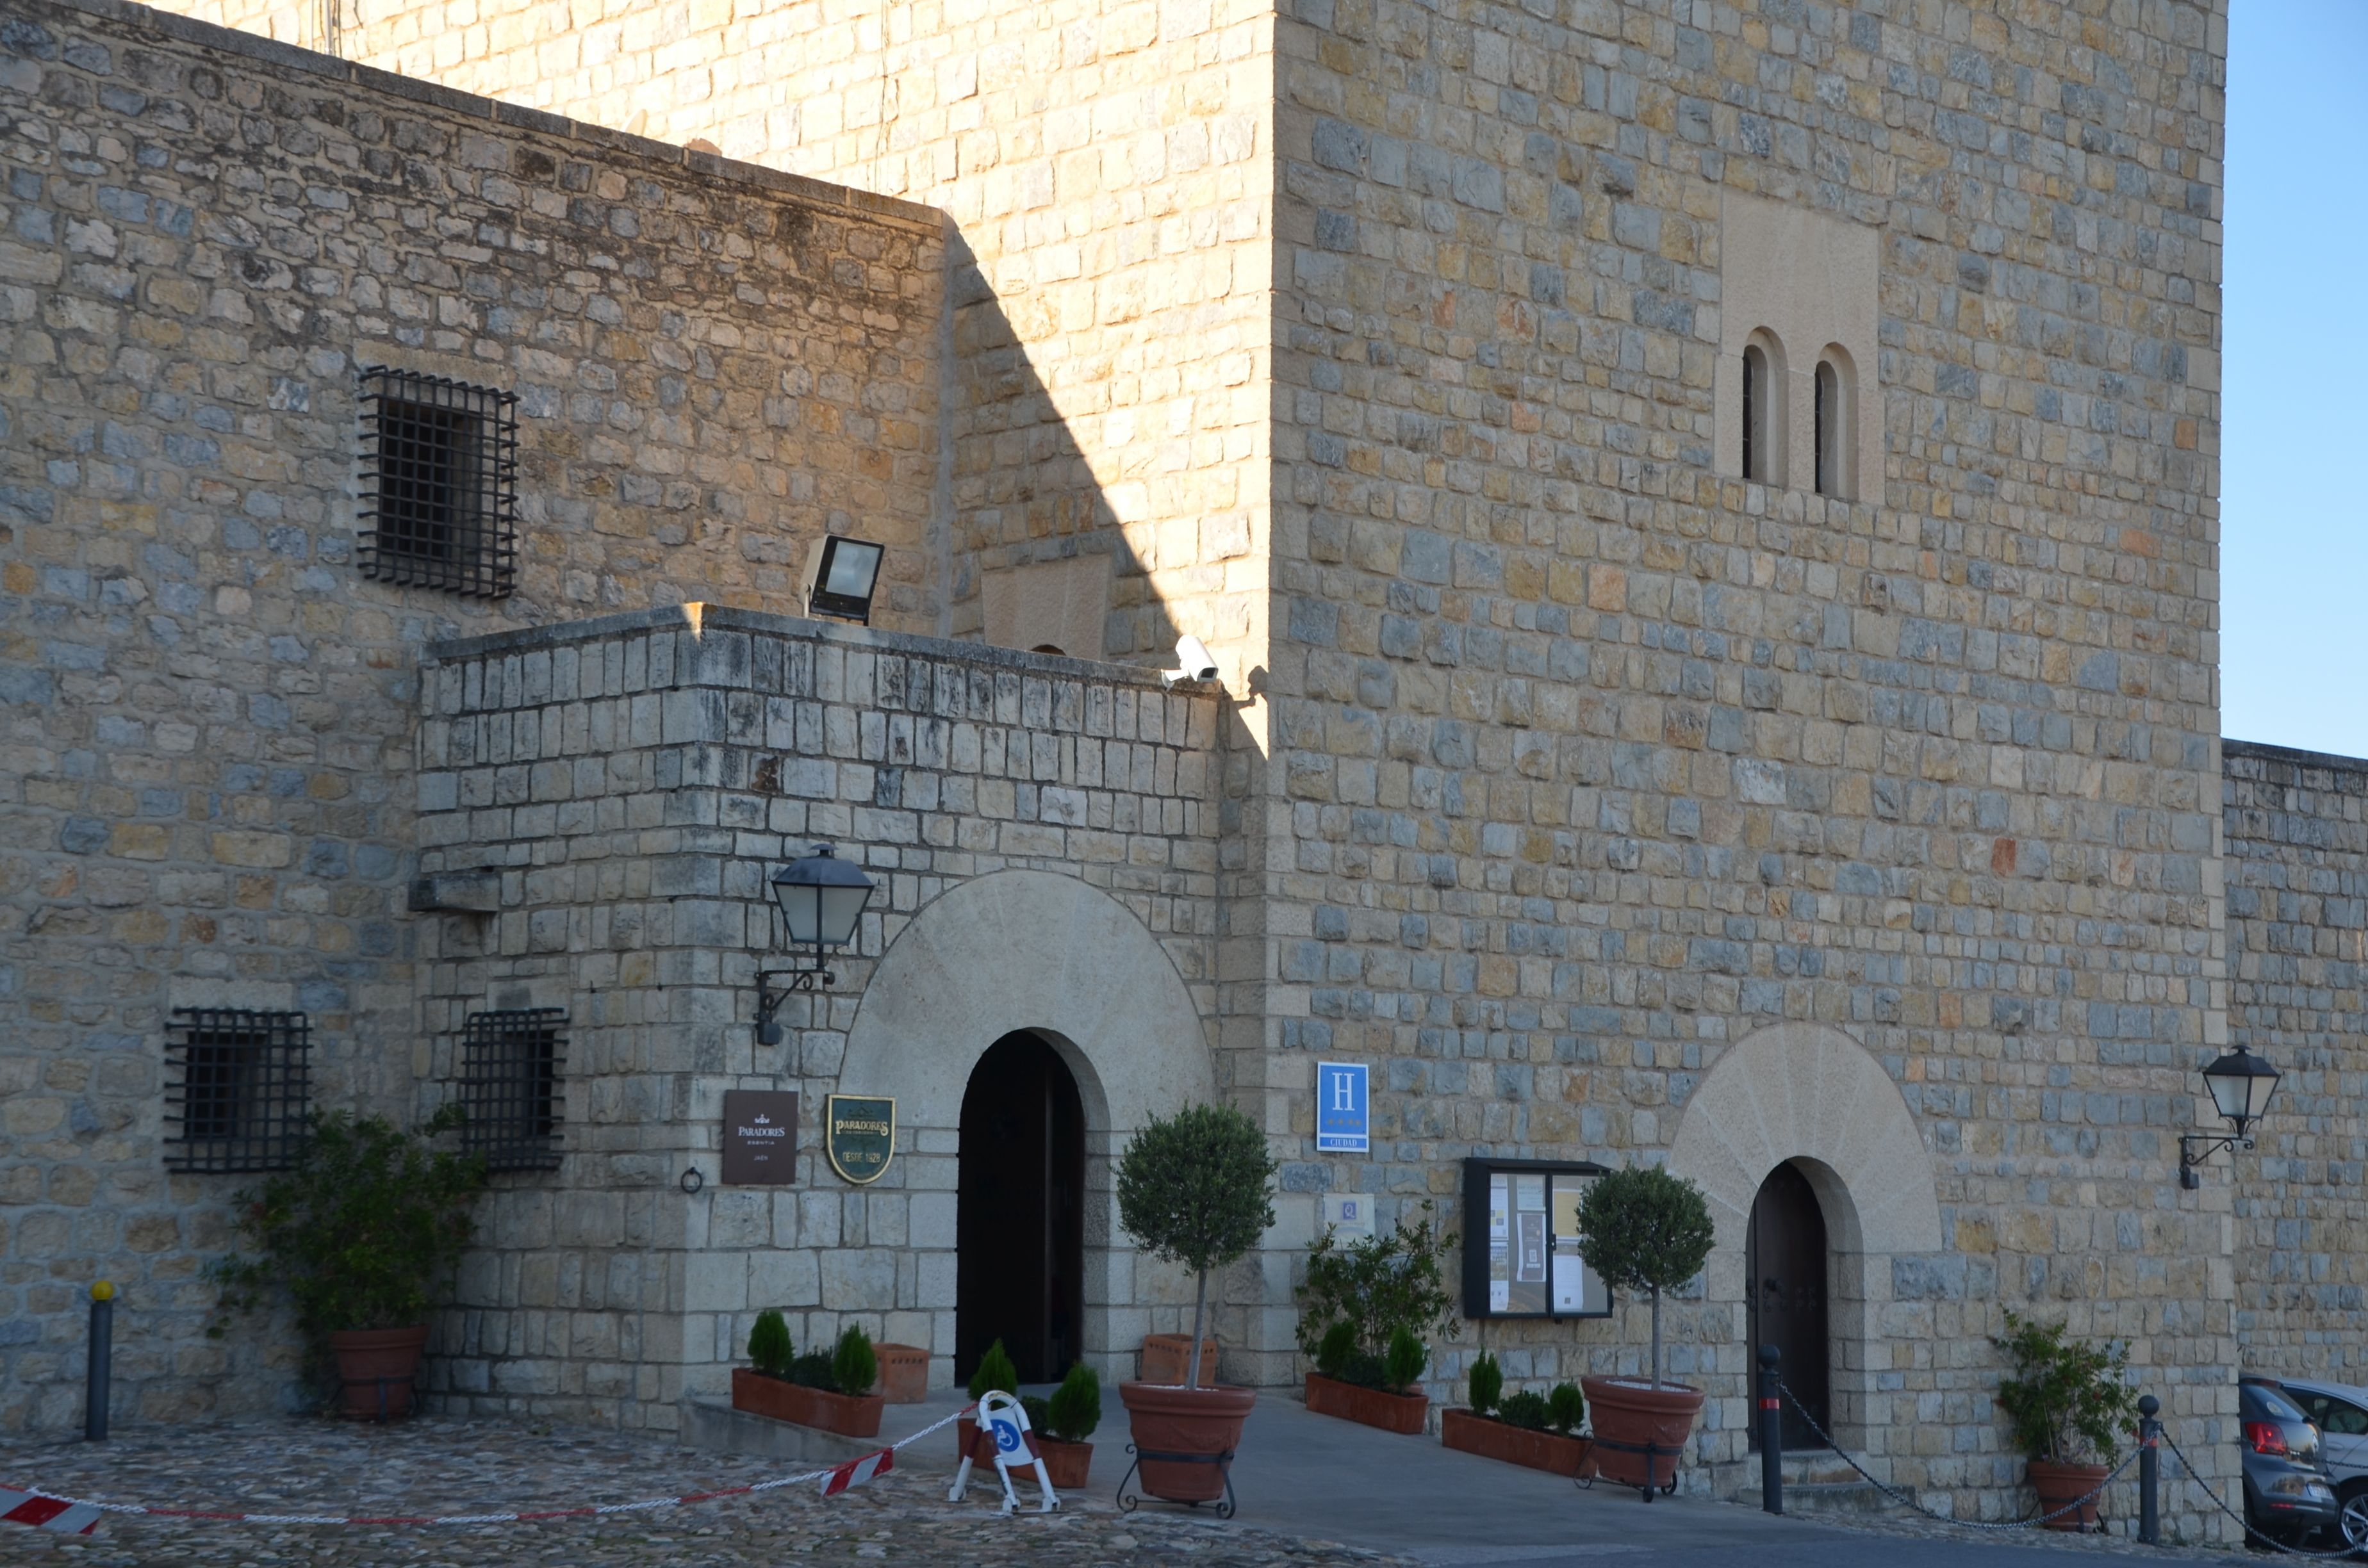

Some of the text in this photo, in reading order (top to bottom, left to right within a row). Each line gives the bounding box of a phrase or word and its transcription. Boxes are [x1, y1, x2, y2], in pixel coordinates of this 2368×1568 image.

[1332, 1072, 1355, 1111] H
[738, 1126, 785, 1137] PARADORES
[835, 1120, 889, 1136] PARADORES
[1330, 1138, 1358, 1147] CIUDAD
[843, 1152, 862, 1163] DESDE
[1345, 1204, 1355, 1218] Q
